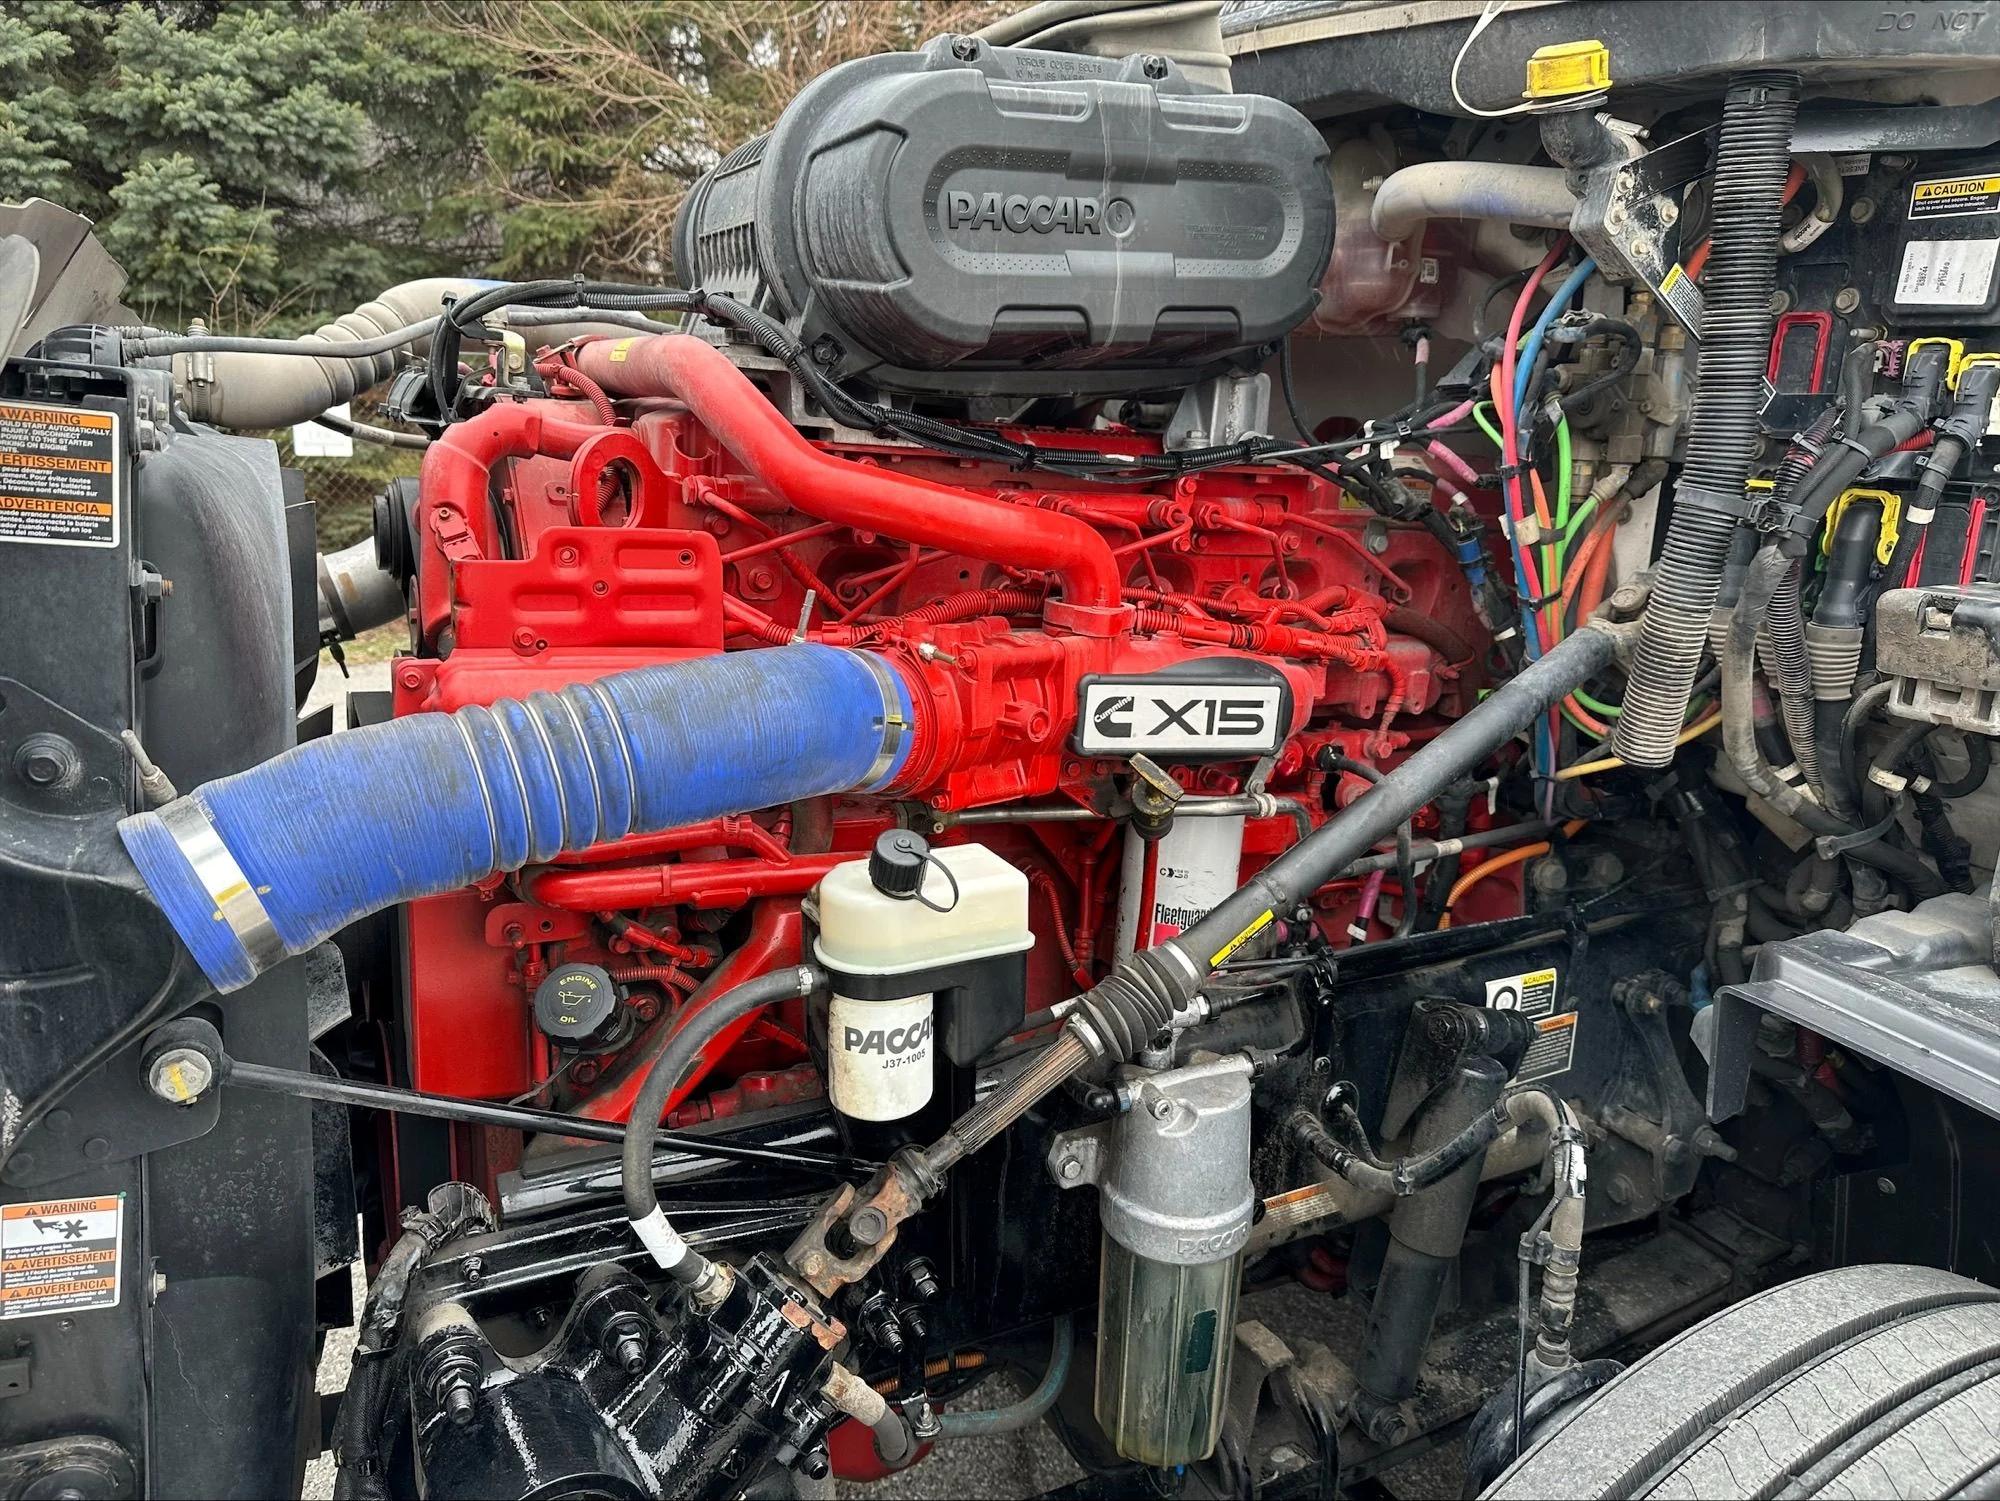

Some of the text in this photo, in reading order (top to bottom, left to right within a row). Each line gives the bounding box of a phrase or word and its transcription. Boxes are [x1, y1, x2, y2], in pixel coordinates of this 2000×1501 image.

[1876, 10, 1987, 32] DO NOT
[1016, 56, 1102, 74] TORQUE COVER BOLTS
[1934, 182, 1985, 196] CAUTION
[948, 190, 1101, 234] PACCAR
[7, 409, 80, 425] WARNING
[22, 421, 47, 430] START
[48, 424, 112, 436] AUTOMATICALLY.
[32, 429, 80, 439] DISCONNECT
[1, 433, 29, 441] POWER
[43, 436, 57, 444] THE
[58, 438, 93, 447] STARTER
[27, 441, 38, 449] ON
[40, 443, 68, 451] ENGINE
[0, 454, 107, 472] ERTISSEMENT
[30, 473, 47, 481] Pour
[61, 482, 91, 490] batteries
[1094, 696, 1132, 723] Cummins
[1147, 699, 1265, 735] X15
[1155, 903, 1214, 930] Fleetguar
[560, 976, 598, 990] ENGINE
[1528, 973, 1554, 984] CAUTION
[560, 1015, 577, 1023] OIL
[882, 1048, 926, 1069] J37-1005
[41, 1201, 97, 1214] WARNING
[21, 1251, 114, 1269] AVERTISSEMENT
[26, 1279, 107, 1297] ADVERTENCIA
